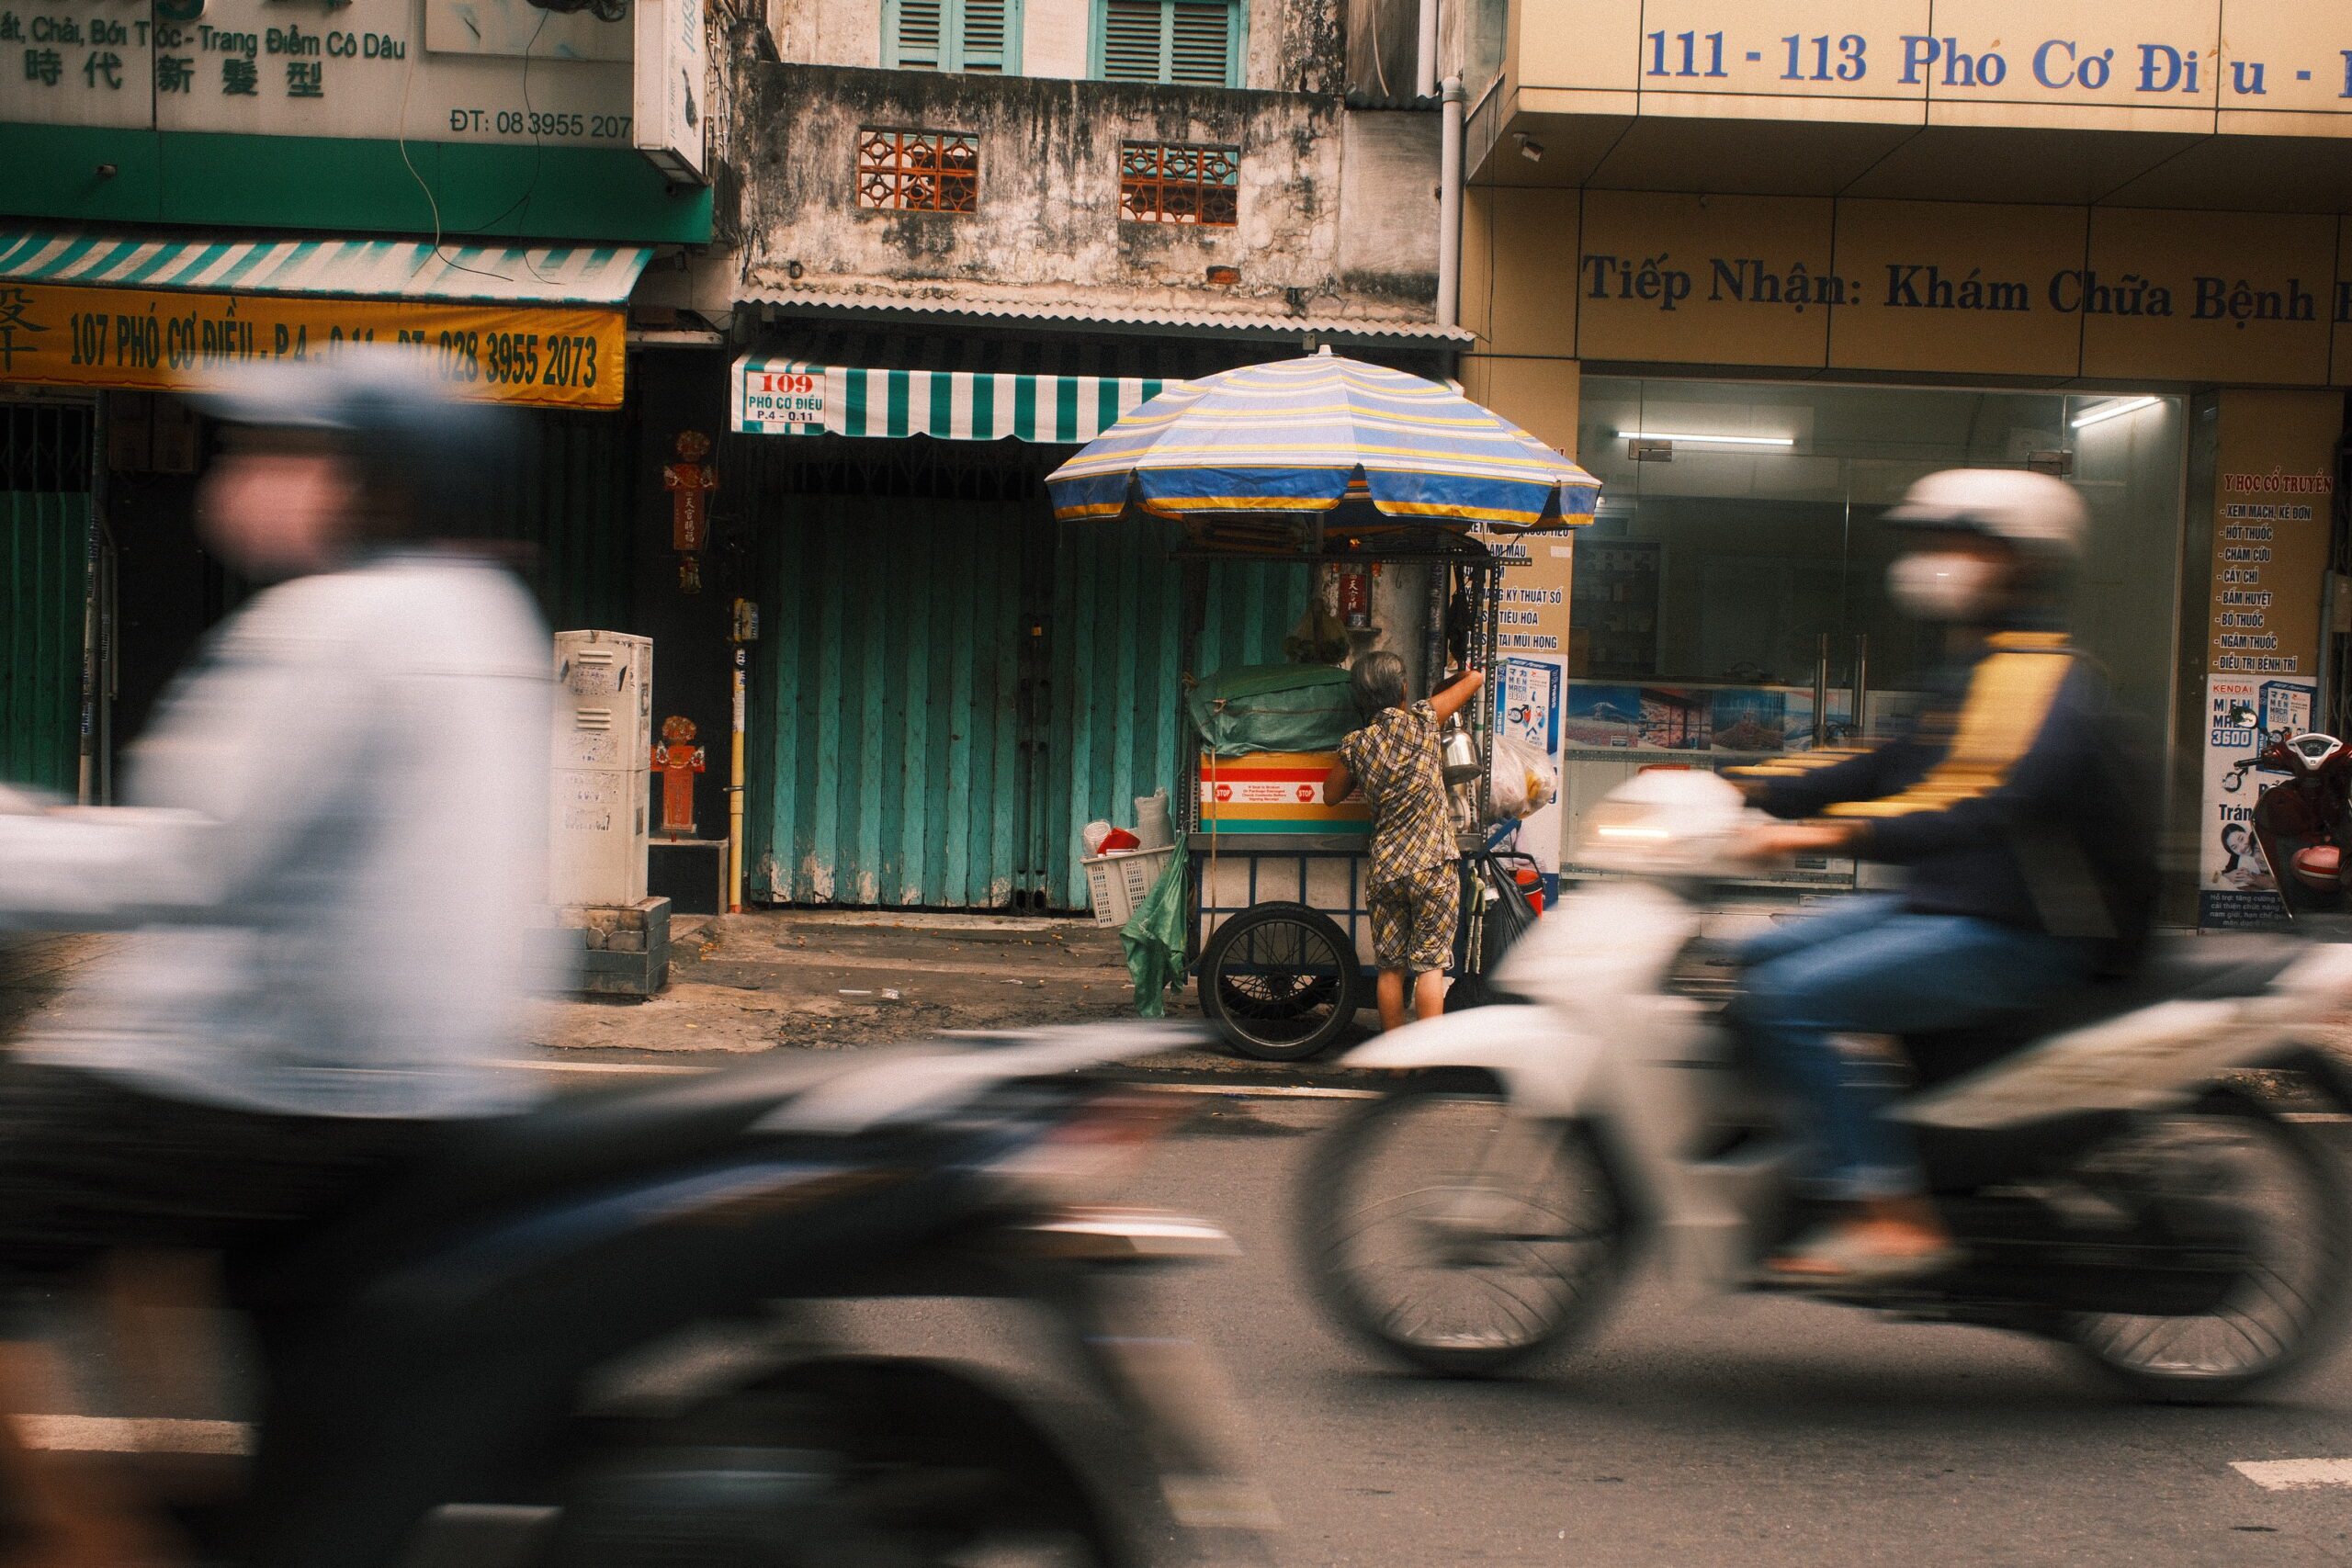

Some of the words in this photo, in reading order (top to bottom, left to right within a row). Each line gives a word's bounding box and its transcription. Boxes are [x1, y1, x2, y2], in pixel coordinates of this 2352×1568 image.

[198, 25, 257, 58] Trang
[326, 30, 357, 58] Cô
[364, 33, 405, 60] Dâu
[1646, 29, 1728, 78] 111
[1746, 51, 1761, 62] -
[1780, 34, 1867, 82] 113
[2032, 39, 2113, 89] Cơ
[450, 109, 489, 132] ĐT:
[1582, 253, 1690, 311] Tiếp
[1708, 258, 1860, 313] Nhận:
[1883, 264, 2030, 311] Khám
[2049, 269, 2173, 317] Chữa
[2190, 276, 2316, 330] Bệnh
[71, 313, 108, 366] 107
[116, 302, 161, 368] PHÓ
[167, 310, 198, 369] CƠ
[486, 333, 538, 384] 3955
[542, 334, 597, 388] 2073
[760, 374, 813, 393] 109
[749, 394, 772, 409] PHÓ
[758, 411, 775, 420] P.4
[788, 412, 812, 421] Q.11
[2224, 474, 2233, 491] Y
[2235, 474, 2261, 495] HỌC
[2226, 504, 2246, 518] XEM
[1498, 634, 1510, 647] TAI
[1533, 636, 1557, 651] HỌNG
[2211, 730, 2250, 746] 3600
[1216, 789, 1230, 797] STOP
[1298, 789, 1312, 797] STOP
